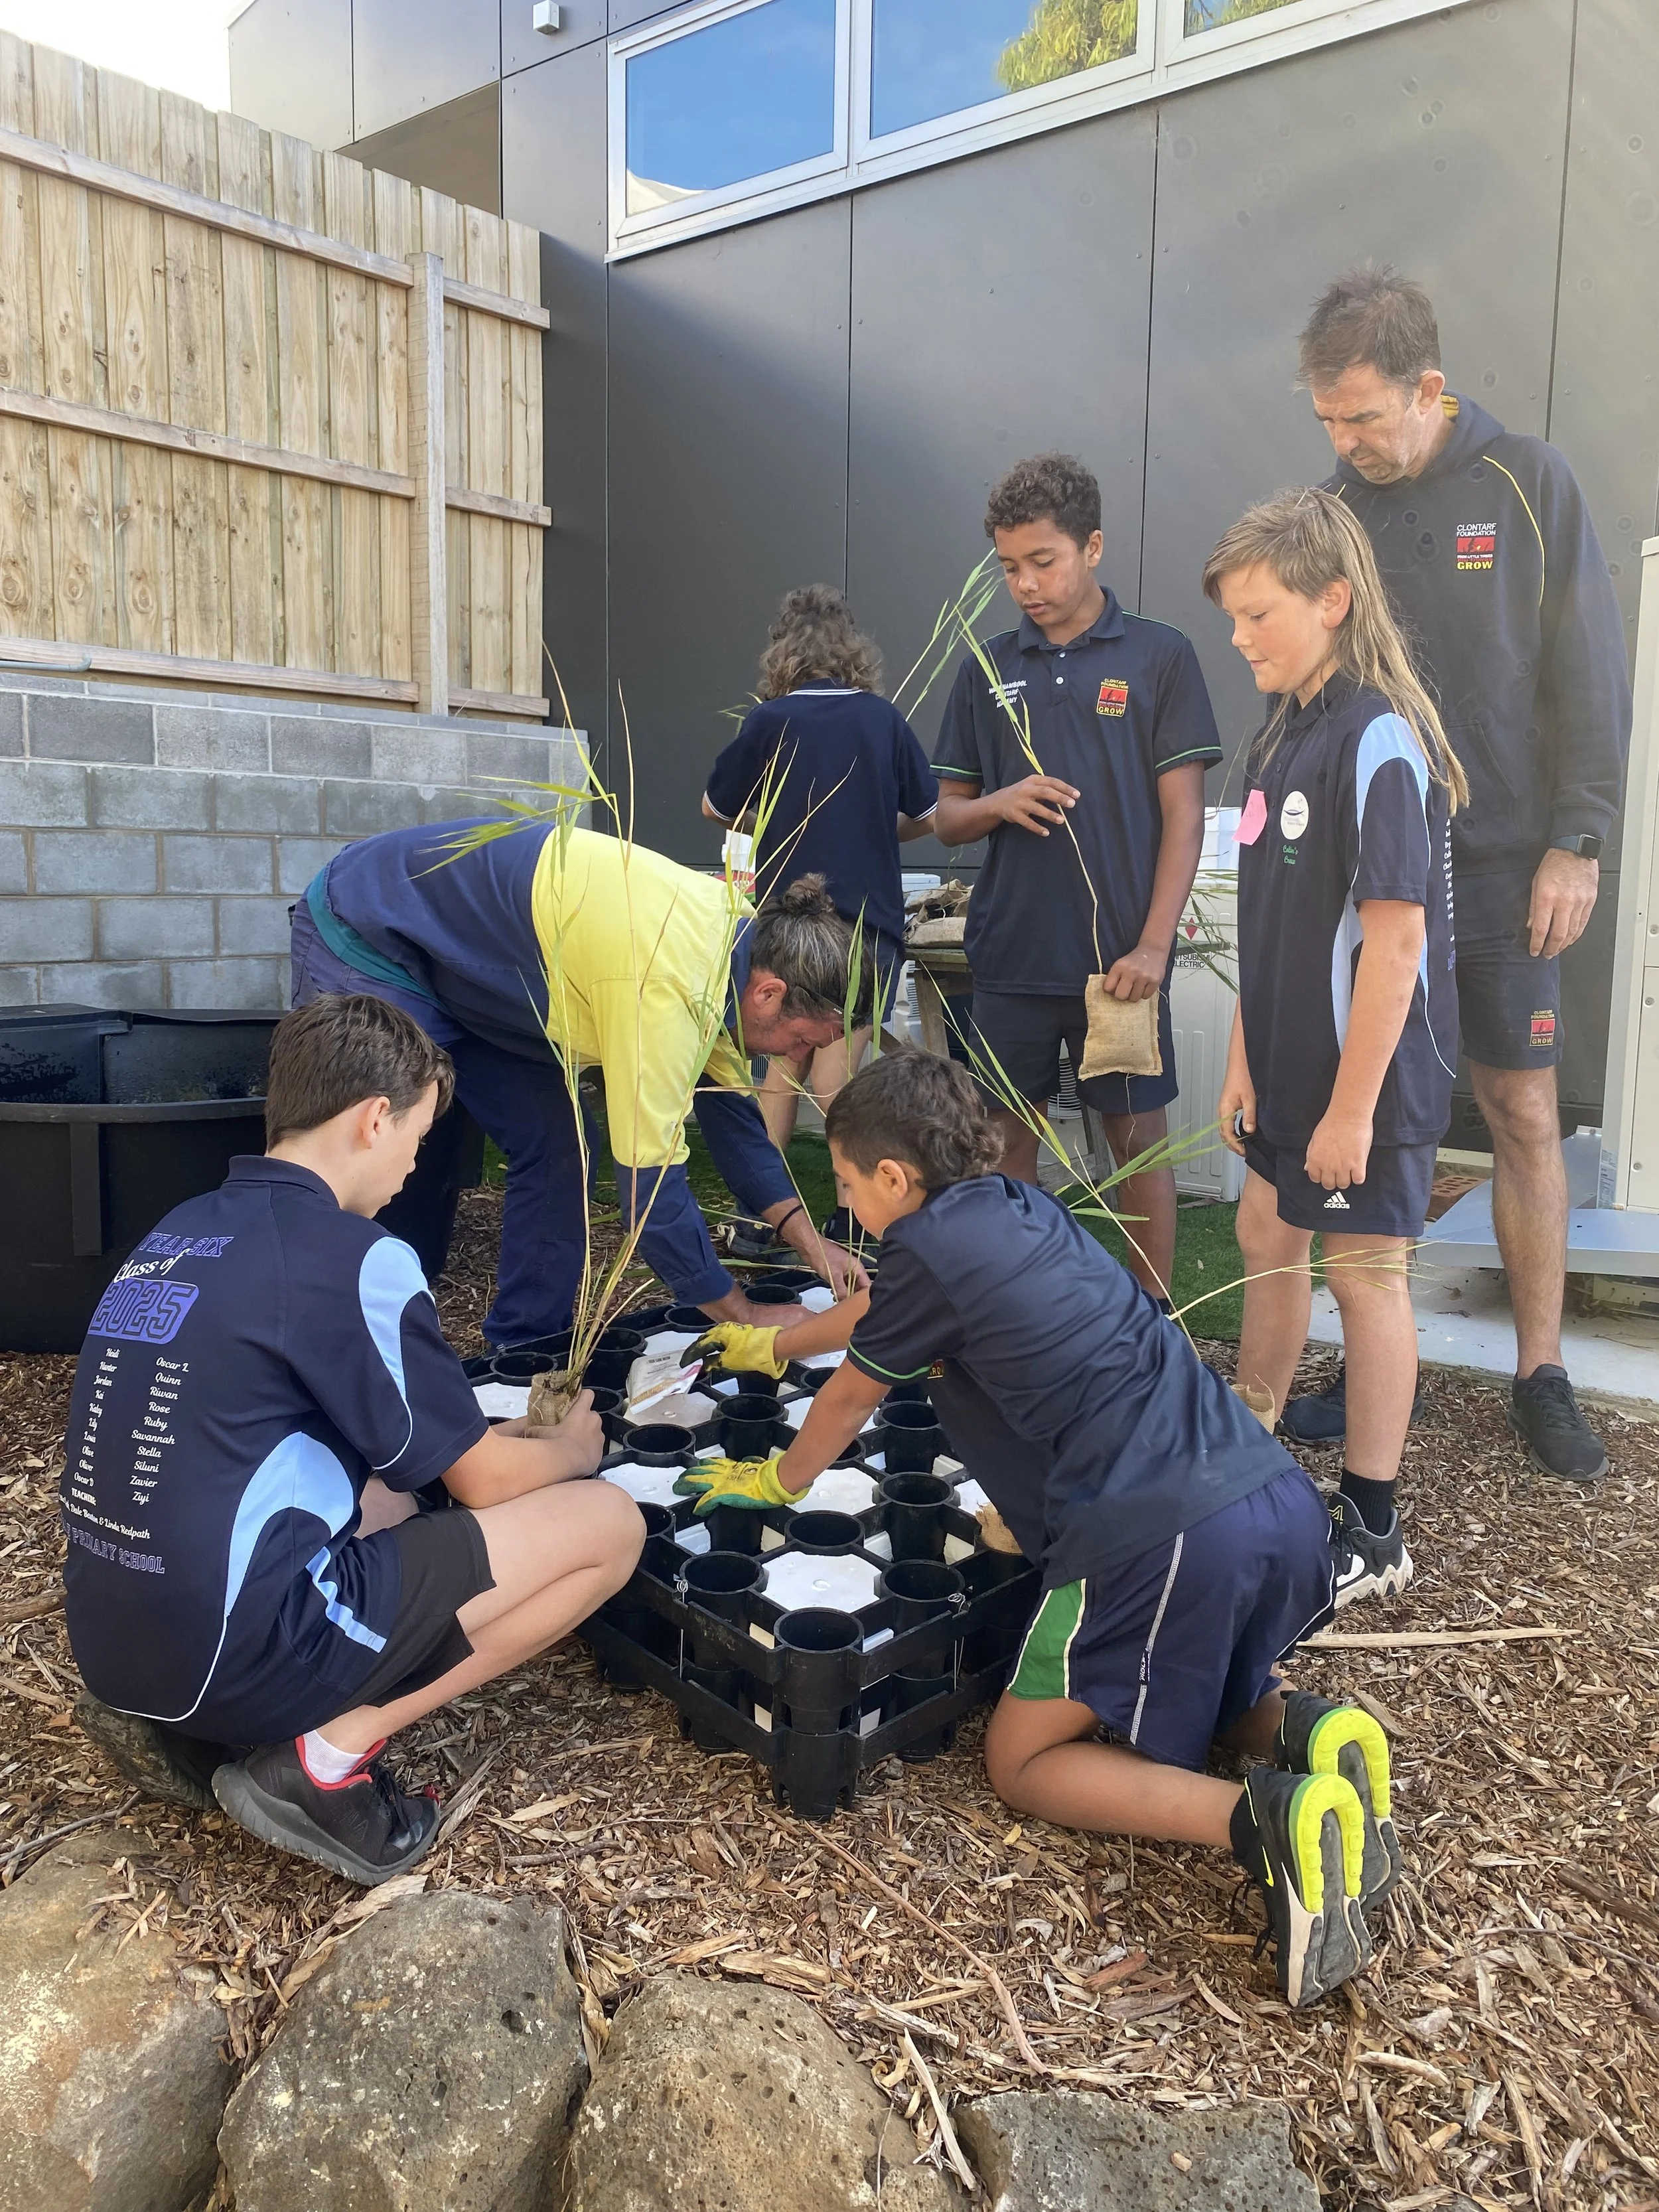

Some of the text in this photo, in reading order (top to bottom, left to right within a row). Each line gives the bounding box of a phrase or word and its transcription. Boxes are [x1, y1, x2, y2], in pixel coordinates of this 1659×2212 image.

[1457, 523, 1497, 532] CLONTARF
[1457, 561, 1493, 570] GROW
[1098, 707, 1123, 715] GROW
[138, 1232, 234, 1258] YEAR SIX
[113, 1248, 191, 1284] Class of
[90, 1278, 196, 1339] 2025
[106, 1348, 120, 1358] Heidi
[156, 1357, 181, 1370] Oscar
[94, 1375, 112, 1386] Jordan
[155, 1372, 181, 1385] Quinn
[150, 1386, 179, 1400] Riwan
[149, 1401, 171, 1414] Rose
[144, 1416, 168, 1432] Ruby
[131, 1429, 175, 1445] Savannah
[137, 1445, 162, 1457] Stella
[79, 1459, 94, 1471] Oliver
[134, 1460, 159, 1473] Siluni
[74, 1472, 89, 1485] Oscar
[129, 1475, 158, 1487] Zavier
[70, 1503, 82, 1516] Dale
[99, 1516, 104, 1525] &
[104, 1518, 120, 1532] Linda
[120, 1524, 151, 1540] Redpath
[118, 1548, 165, 1574] SCHOOL
